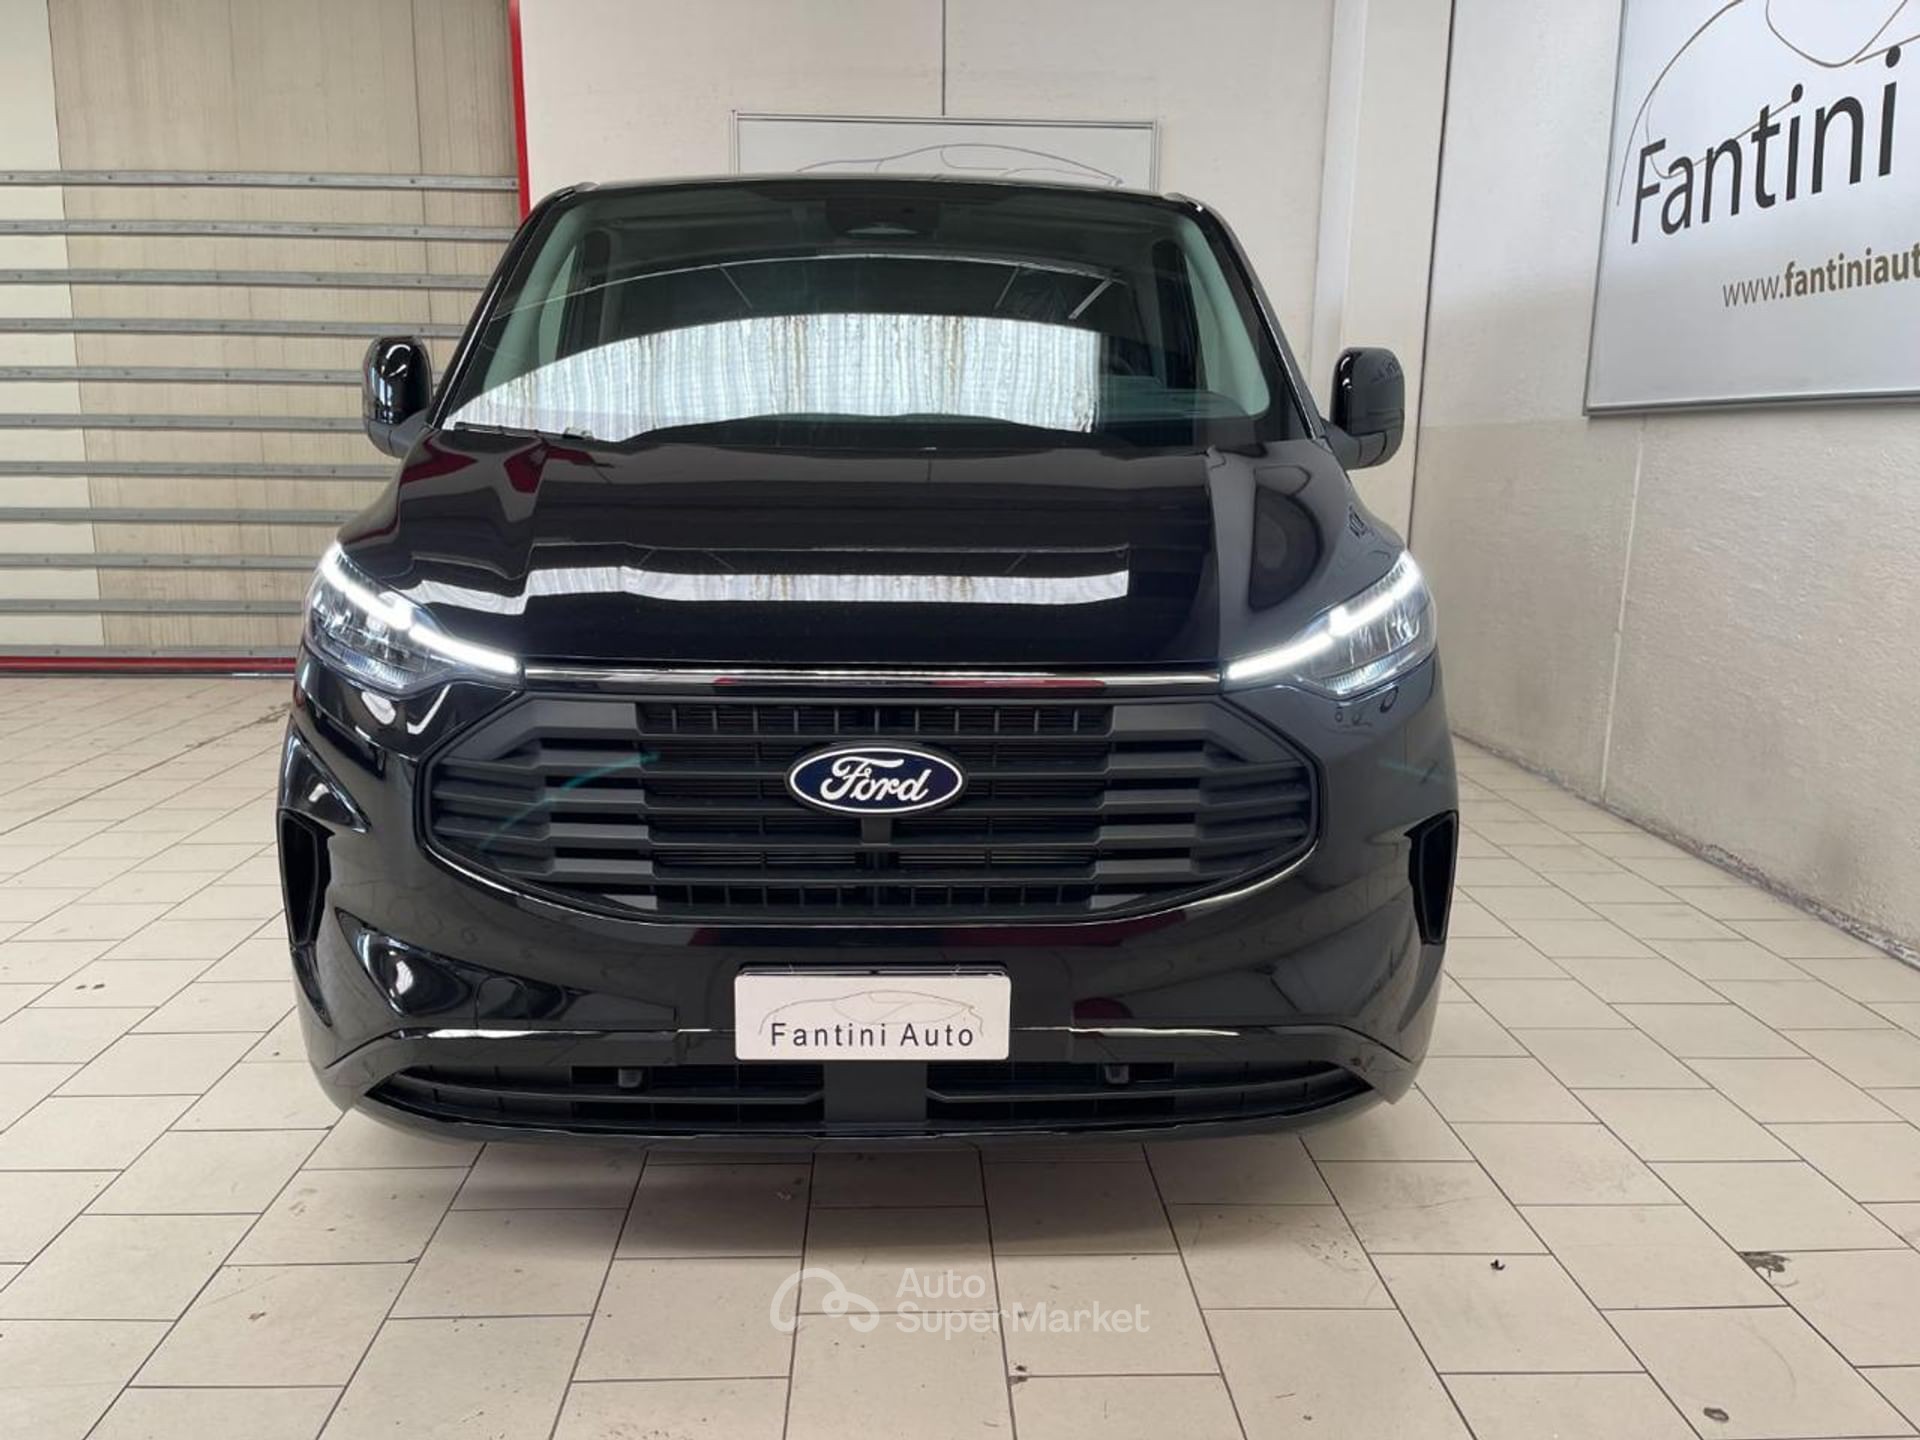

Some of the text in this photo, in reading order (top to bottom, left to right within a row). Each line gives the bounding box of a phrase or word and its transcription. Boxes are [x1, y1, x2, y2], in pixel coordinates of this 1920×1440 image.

[1631, 45, 1901, 244] Fantini
[820, 756, 932, 801] Ford
[771, 1022, 974, 1046] Fantini Auto
